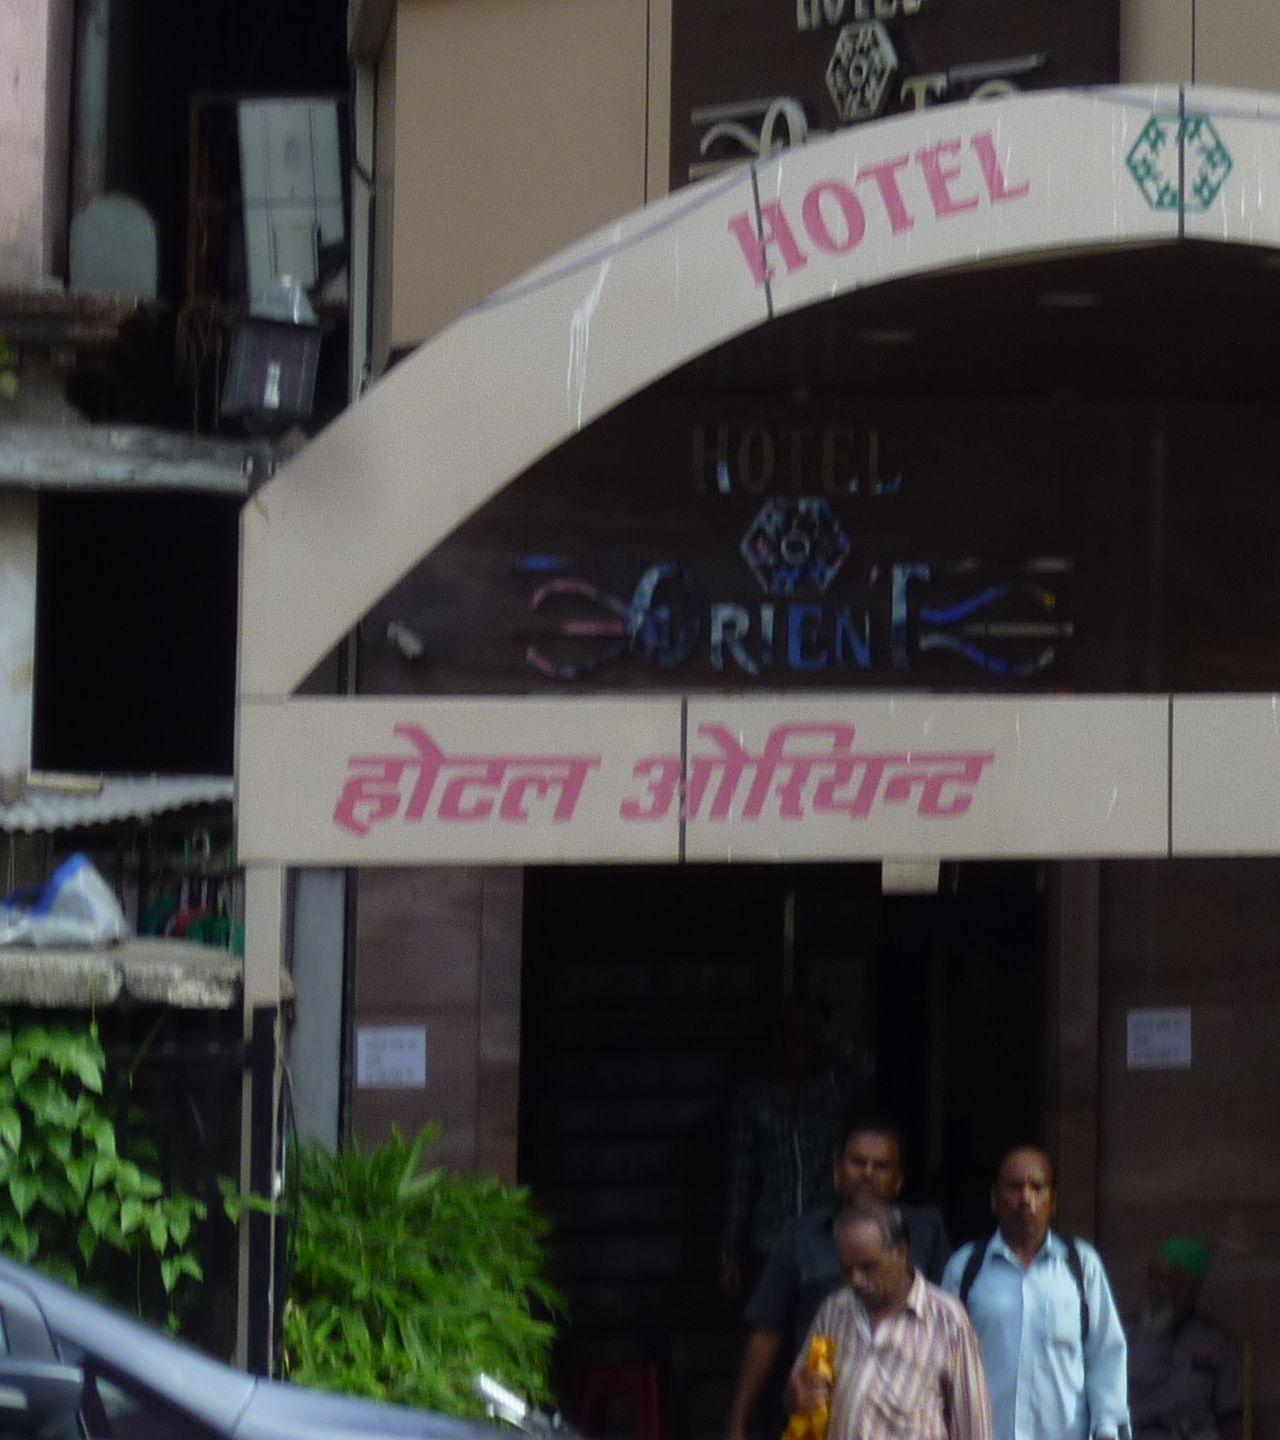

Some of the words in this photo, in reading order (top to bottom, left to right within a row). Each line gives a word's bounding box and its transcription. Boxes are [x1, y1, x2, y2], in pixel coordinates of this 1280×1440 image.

[727, 131, 1030, 290] HOTEL
[690, 421, 904, 496] HOTEL
[333, 721, 602, 838] होटल
